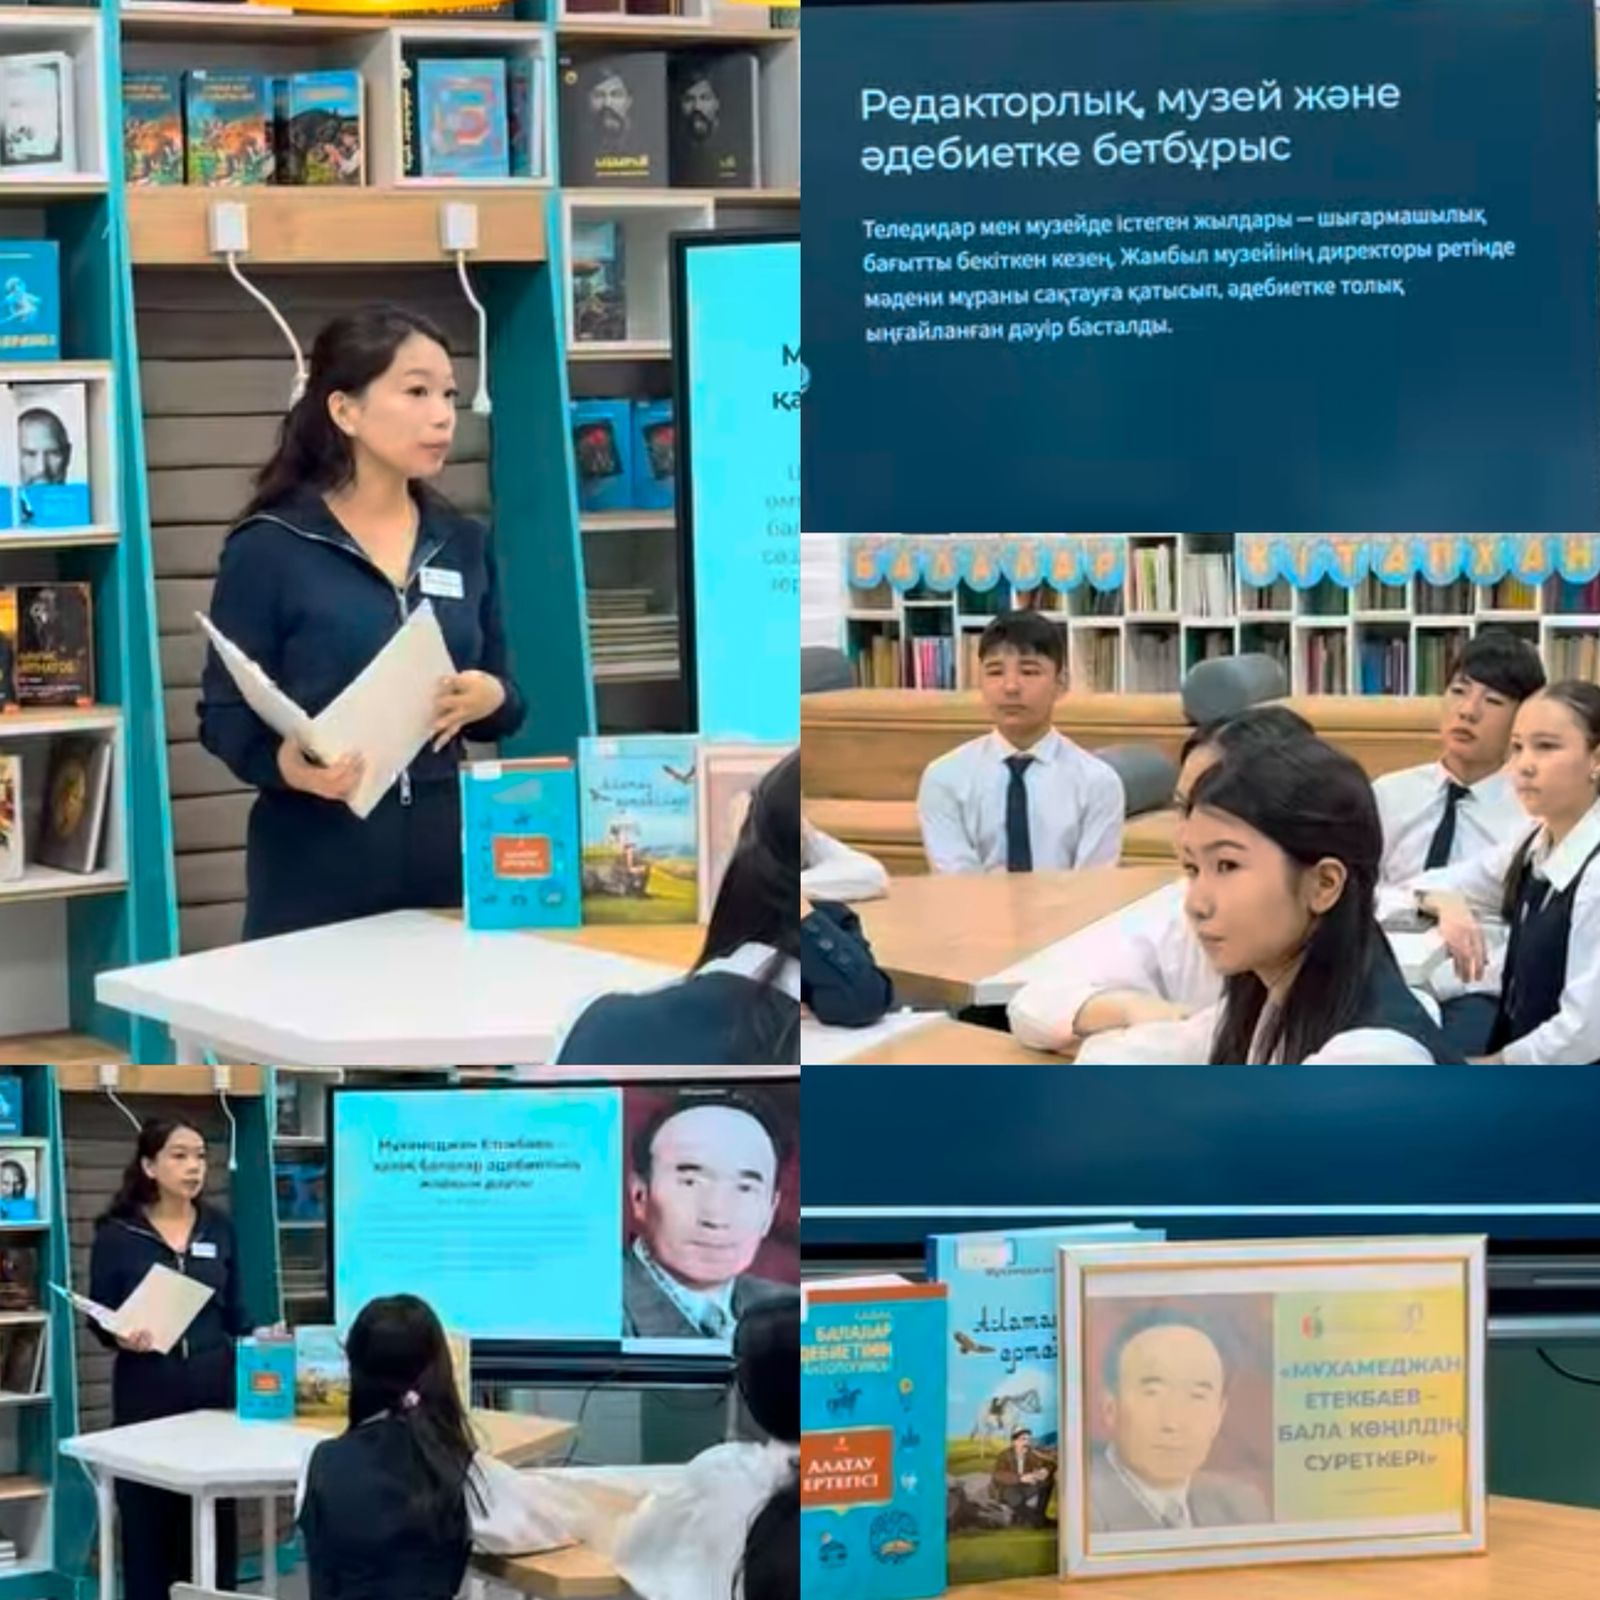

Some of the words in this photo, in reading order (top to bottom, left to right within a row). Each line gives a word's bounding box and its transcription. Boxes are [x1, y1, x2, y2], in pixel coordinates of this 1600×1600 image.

[861, 88, 1145, 124] Редакторлық,
[1157, 78, 1283, 121] музей
[1293, 82, 1401, 112] және
[860, 135, 1081, 176] әдебиетке
[1092, 129, 1292, 171] бетбұрыс
[862, 218, 976, 242] Теледидар
[980, 218, 1021, 237] мен
[1025, 213, 1113, 241] музейде
[1116, 213, 1190, 233] істеген
[1193, 211, 1293, 233] жылдары
[1317, 207, 1488, 231] шығармашылық
[862, 252, 953, 273] бағытты
[956, 250, 1047, 271] бекіткен
[1119, 244, 1209, 266] Жамбыл
[1213, 240, 1314, 268] музейінің
[1316, 241, 1432, 264] директоры
[1436, 237, 1517, 262] ретінде
[864, 289, 945, 312] мәдени
[949, 288, 1029, 311] мұраны
[1032, 285, 1123, 308] сақтауға
[1127, 281, 1224, 306] қатысып,
[1227, 276, 1337, 301] әдебиетке
[1339, 277, 1406, 297] толық
[865, 320, 1003, 346] ыңғайланған
[1007, 317, 1064, 341] дәуір
[1067, 314, 1174, 339] басталды.
[1304, 1388, 1422, 1410] ЕТЕКБАЕВ
[1278, 1422, 1343, 1443] БАЛА
[807, 1457, 876, 1475] АЛАТАУ
